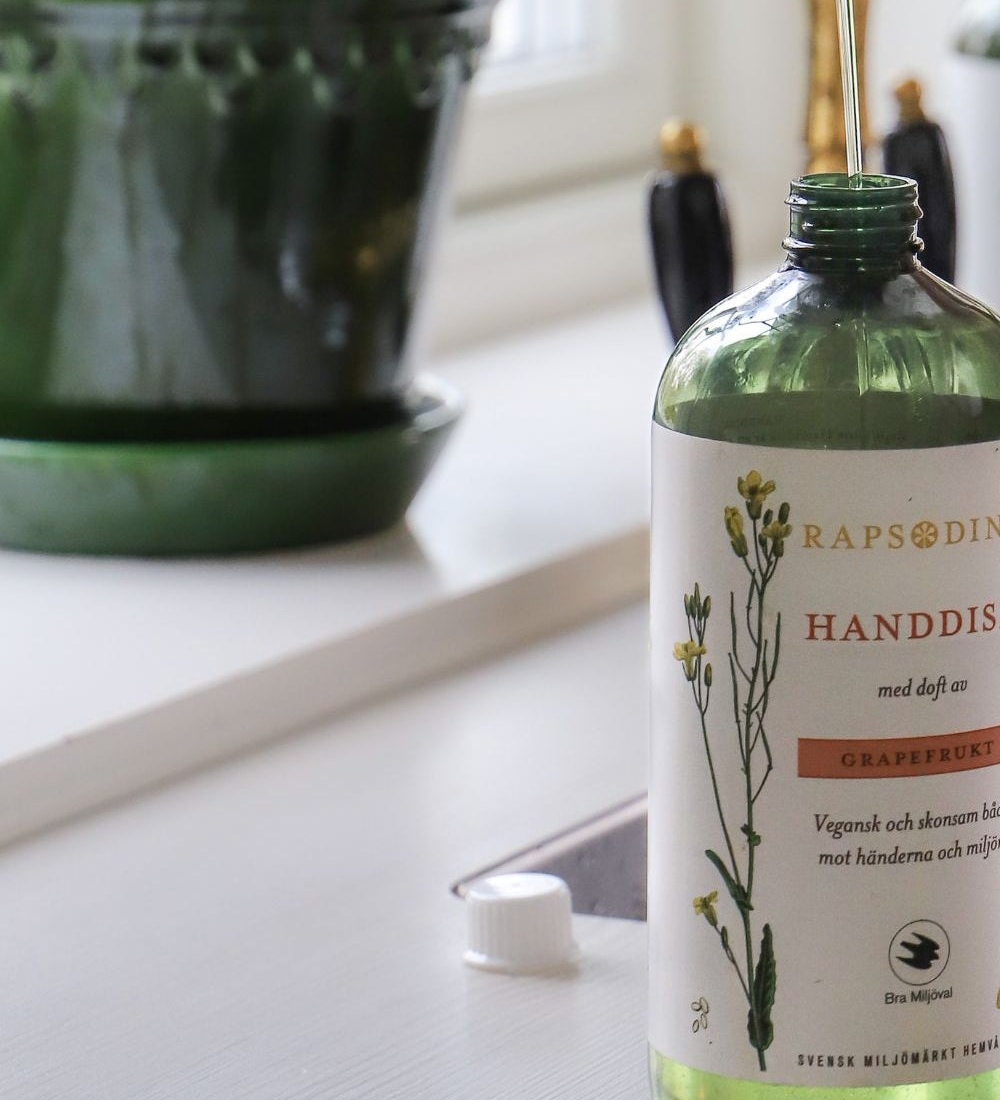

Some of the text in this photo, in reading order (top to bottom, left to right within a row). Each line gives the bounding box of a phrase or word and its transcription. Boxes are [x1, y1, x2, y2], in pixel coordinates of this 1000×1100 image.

[876, 675, 969, 703] med doft av
[840, 739, 996, 768] GRAPEFRUKT
[813, 812, 882, 840] Vegansk
[885, 816, 914, 833] och
[917, 810, 979, 831] skonsam
[818, 849, 852, 867] mot
[855, 846, 934, 867] händerna
[937, 844, 963, 862] och
[884, 986, 953, 1005] Bra Miljöval
[797, 1052, 856, 1069] SVENSK
[863, 1046, 958, 1068] MILJÖMÄRKT
